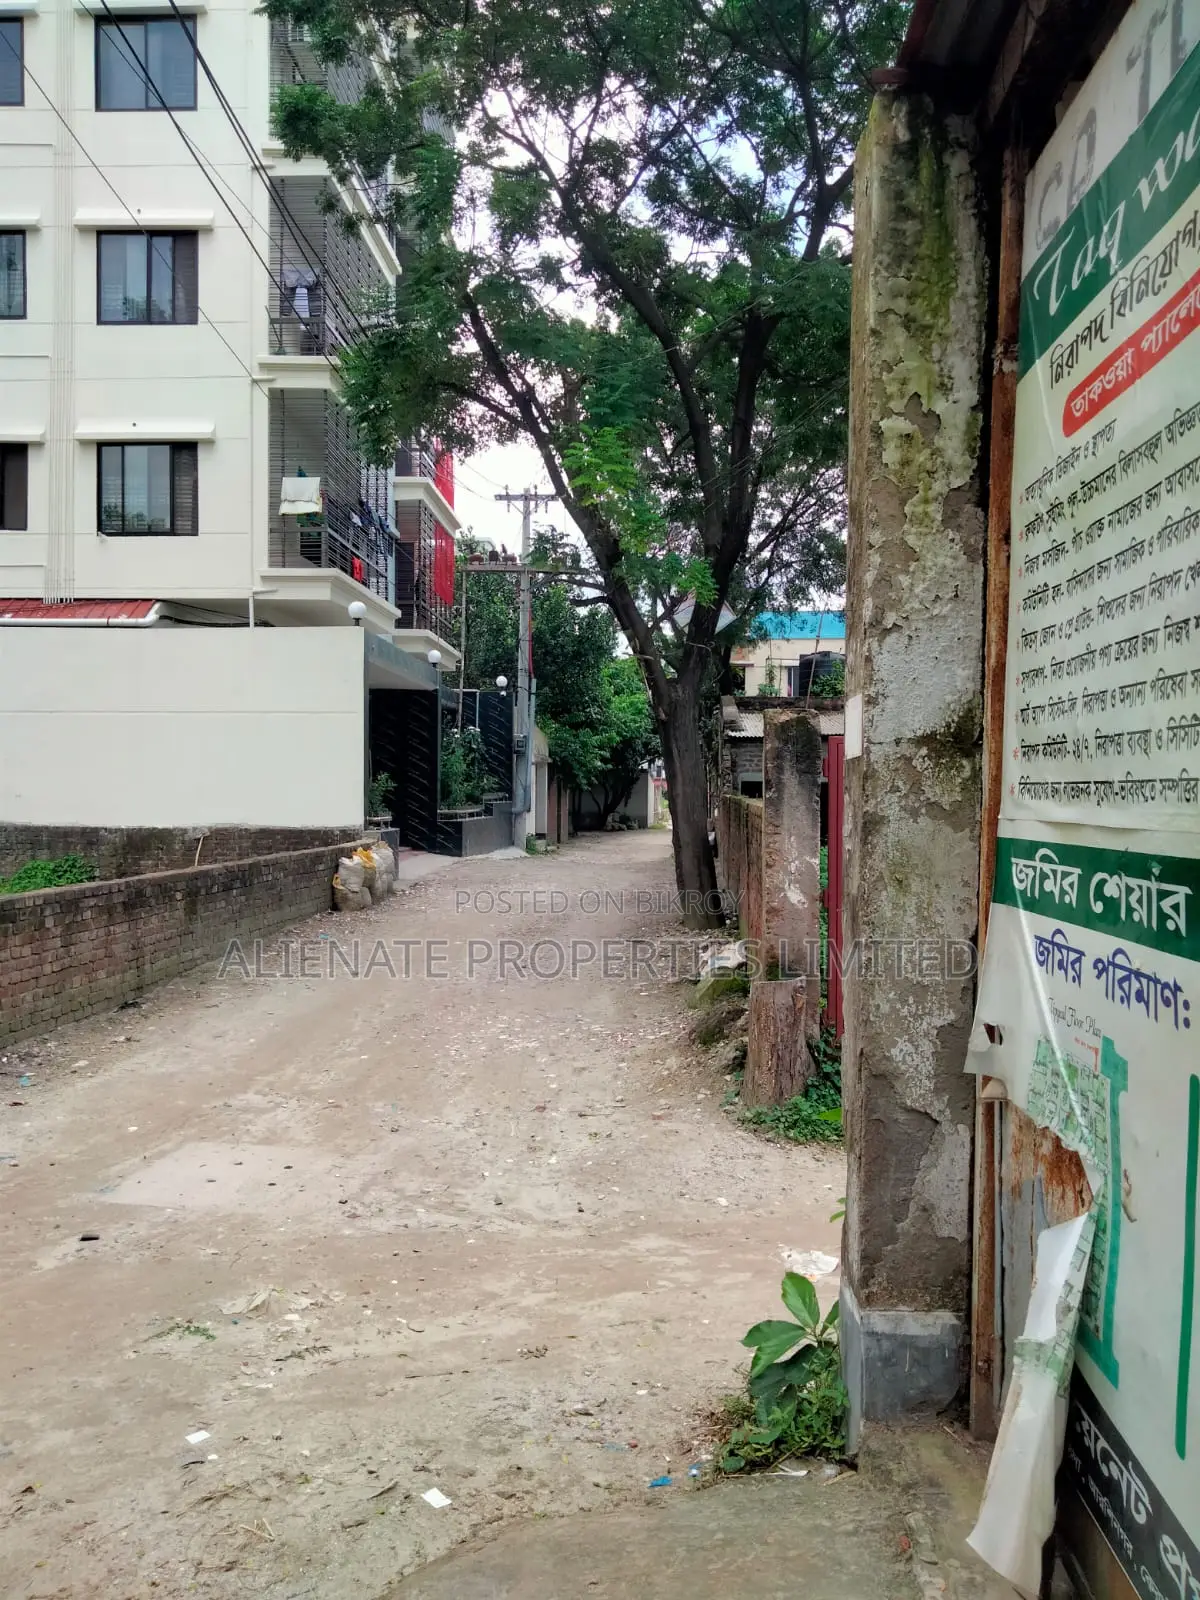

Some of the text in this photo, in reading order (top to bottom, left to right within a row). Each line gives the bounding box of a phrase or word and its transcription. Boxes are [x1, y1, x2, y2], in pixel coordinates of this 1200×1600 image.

[1051, 308, 1108, 389] নিরাপদ
[1070, 347, 1135, 417] তাকওয়া
[1118, 430, 1163, 481] বিলাসবহুল
[1107, 495, 1143, 532] নামাজের
[1145, 481, 1163, 511] জন্য
[1097, 557, 1113, 581] জন্য
[1114, 536, 1146, 574] সামাজিক
[1148, 535, 1154, 556] ও
[1156, 506, 1200, 551] পারিবারিক
[1097, 595, 1128, 624] শিশুদের
[1129, 585, 1147, 611] জন্য
[1148, 569, 1184, 606] নিরাপদ
[1141, 628, 1161, 653] জন্য
[1163, 614, 1191, 650] নিজস্ব
[1082, 686, 1108, 717] নিরাপত্তা
[1111, 688, 1116, 708] ও
[1118, 681, 1147, 708] অন্যান্য
[1150, 667, 1188, 703] পরিষেবা
[1095, 727, 1125, 758] নিরাপত্তা
[1126, 729, 1152, 760] ব্যবস্থা
[1155, 728, 1163, 751] ও
[1050, 781, 1062, 802] জন্য
[1159, 767, 1200, 803] সম্পত্তির
[1011, 848, 1192, 938] জমির শেয়ার
[1034, 928, 1086, 988] জমির
